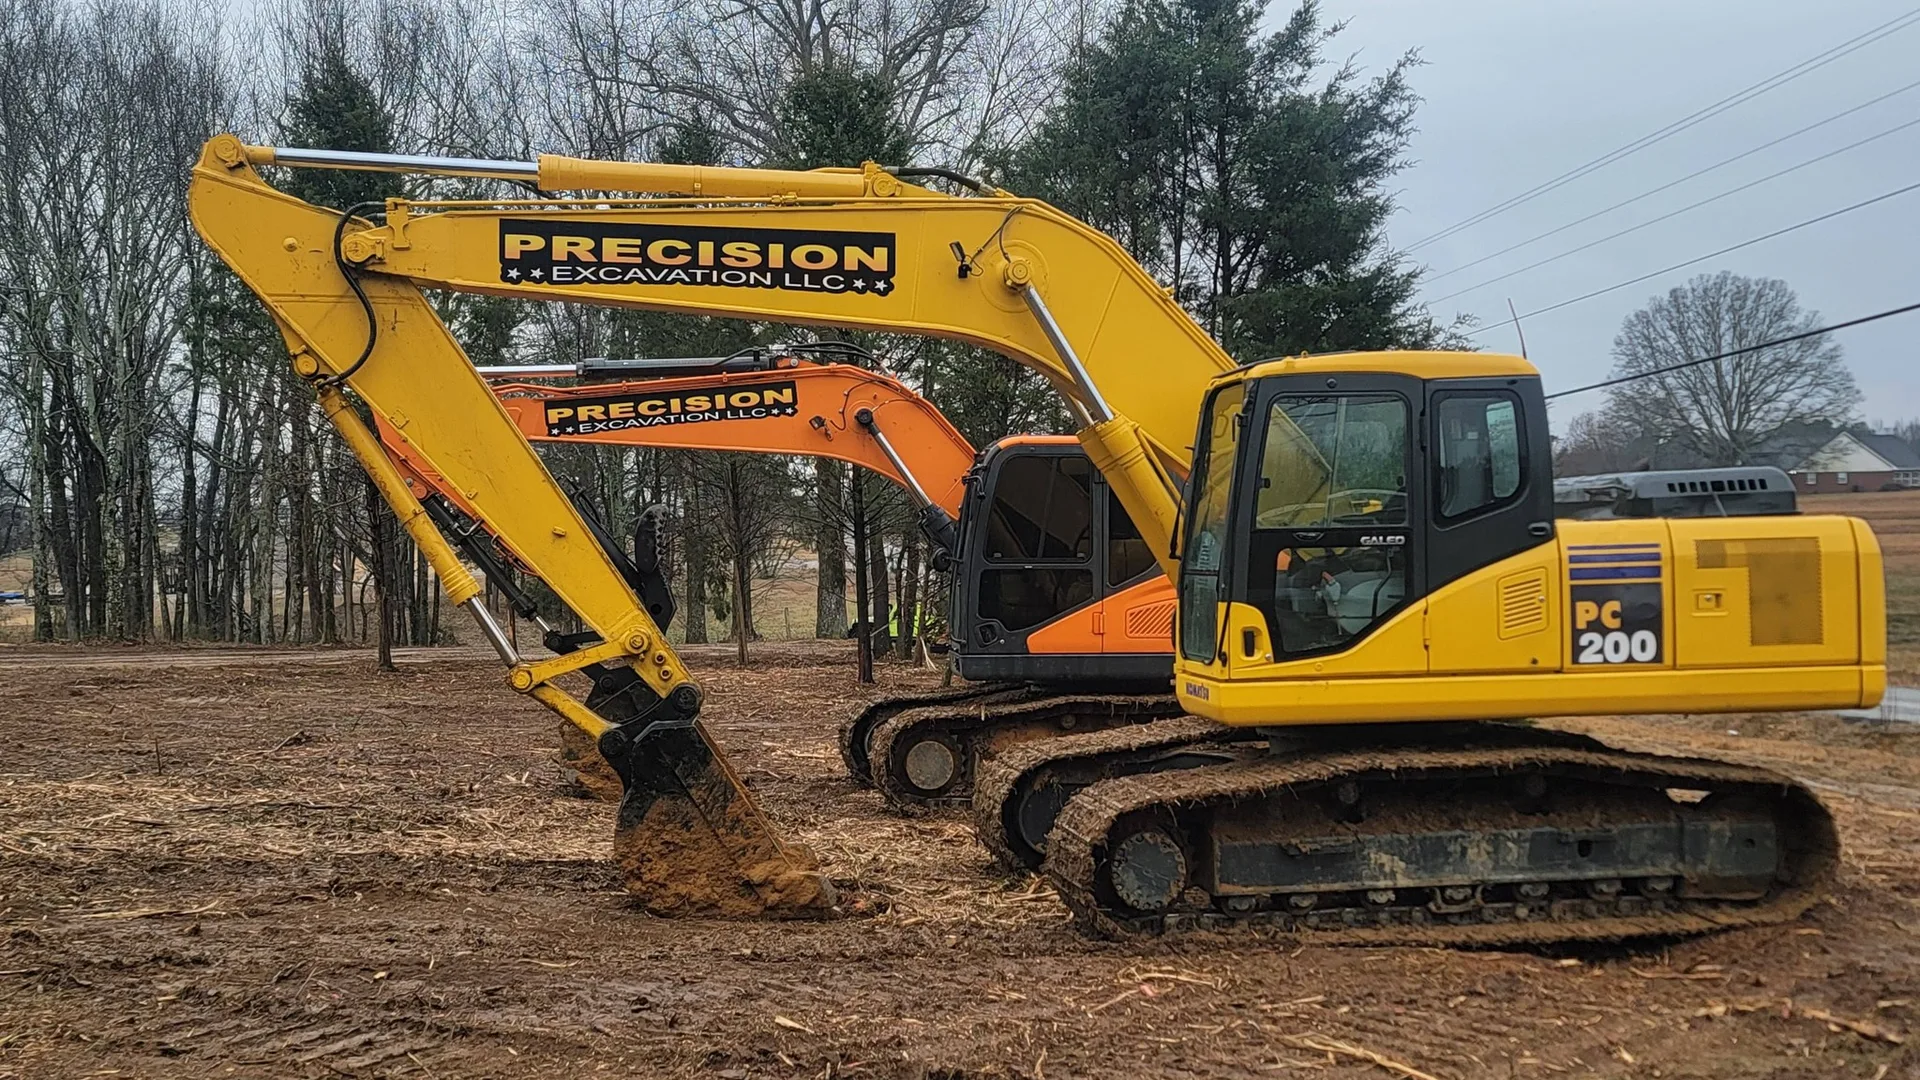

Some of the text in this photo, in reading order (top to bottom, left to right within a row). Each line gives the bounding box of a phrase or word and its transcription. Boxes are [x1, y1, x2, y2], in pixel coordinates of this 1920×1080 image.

[503, 233, 889, 272] PRECISION
[551, 266, 845, 291] EXCAVATION LLC
[547, 388, 793, 424] PRECISION
[579, 407, 767, 433] EXCAVATION LLC
[1575, 600, 1621, 630] PC
[1578, 630, 1658, 664] 200
